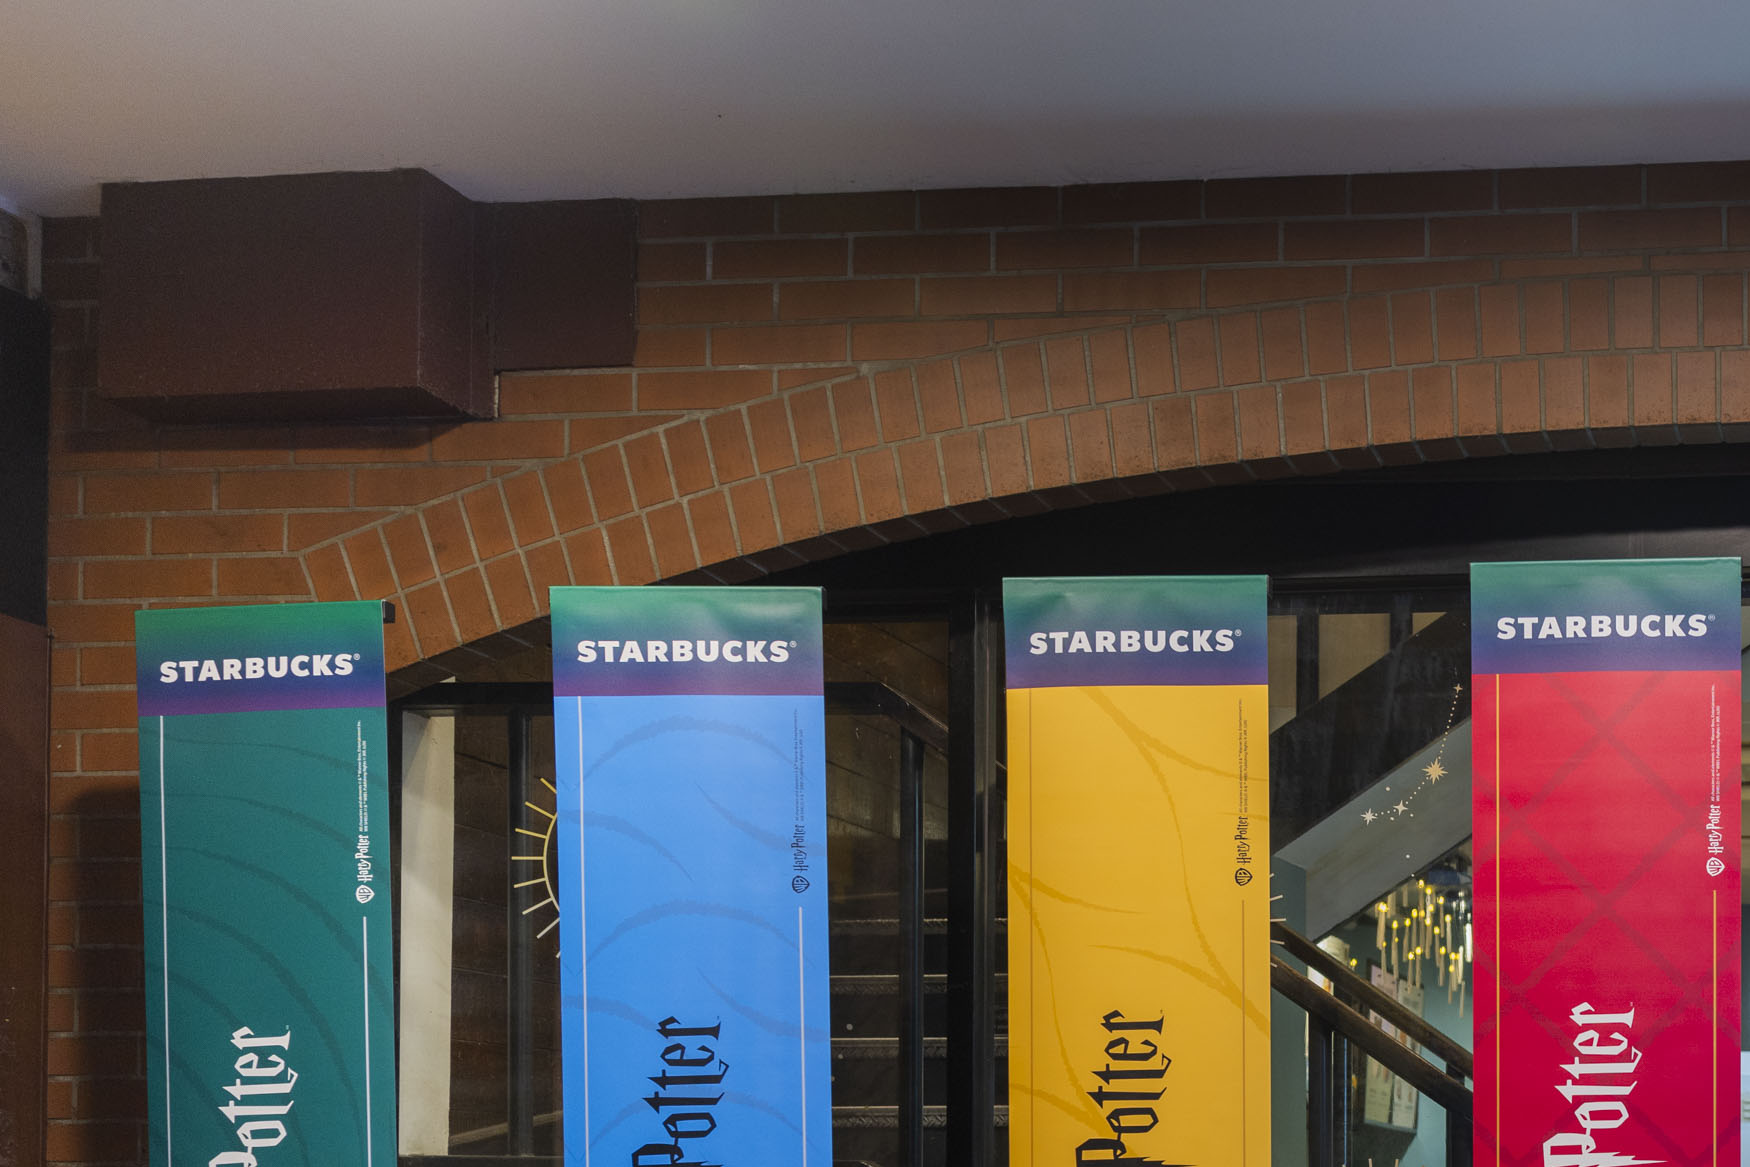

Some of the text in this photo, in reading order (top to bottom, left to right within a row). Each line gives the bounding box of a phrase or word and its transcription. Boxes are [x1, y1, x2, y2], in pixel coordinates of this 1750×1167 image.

[1234, 816, 1251, 841] Potter
[1706, 804, 1725, 830] Potter
[353, 834, 372, 859] Potter
[790, 824, 806, 849] Potter
[1707, 830, 1725, 854] Harry
[791, 848, 809, 872] Harry
[1236, 841, 1252, 865] Harry
[355, 858, 374, 883] Harry
